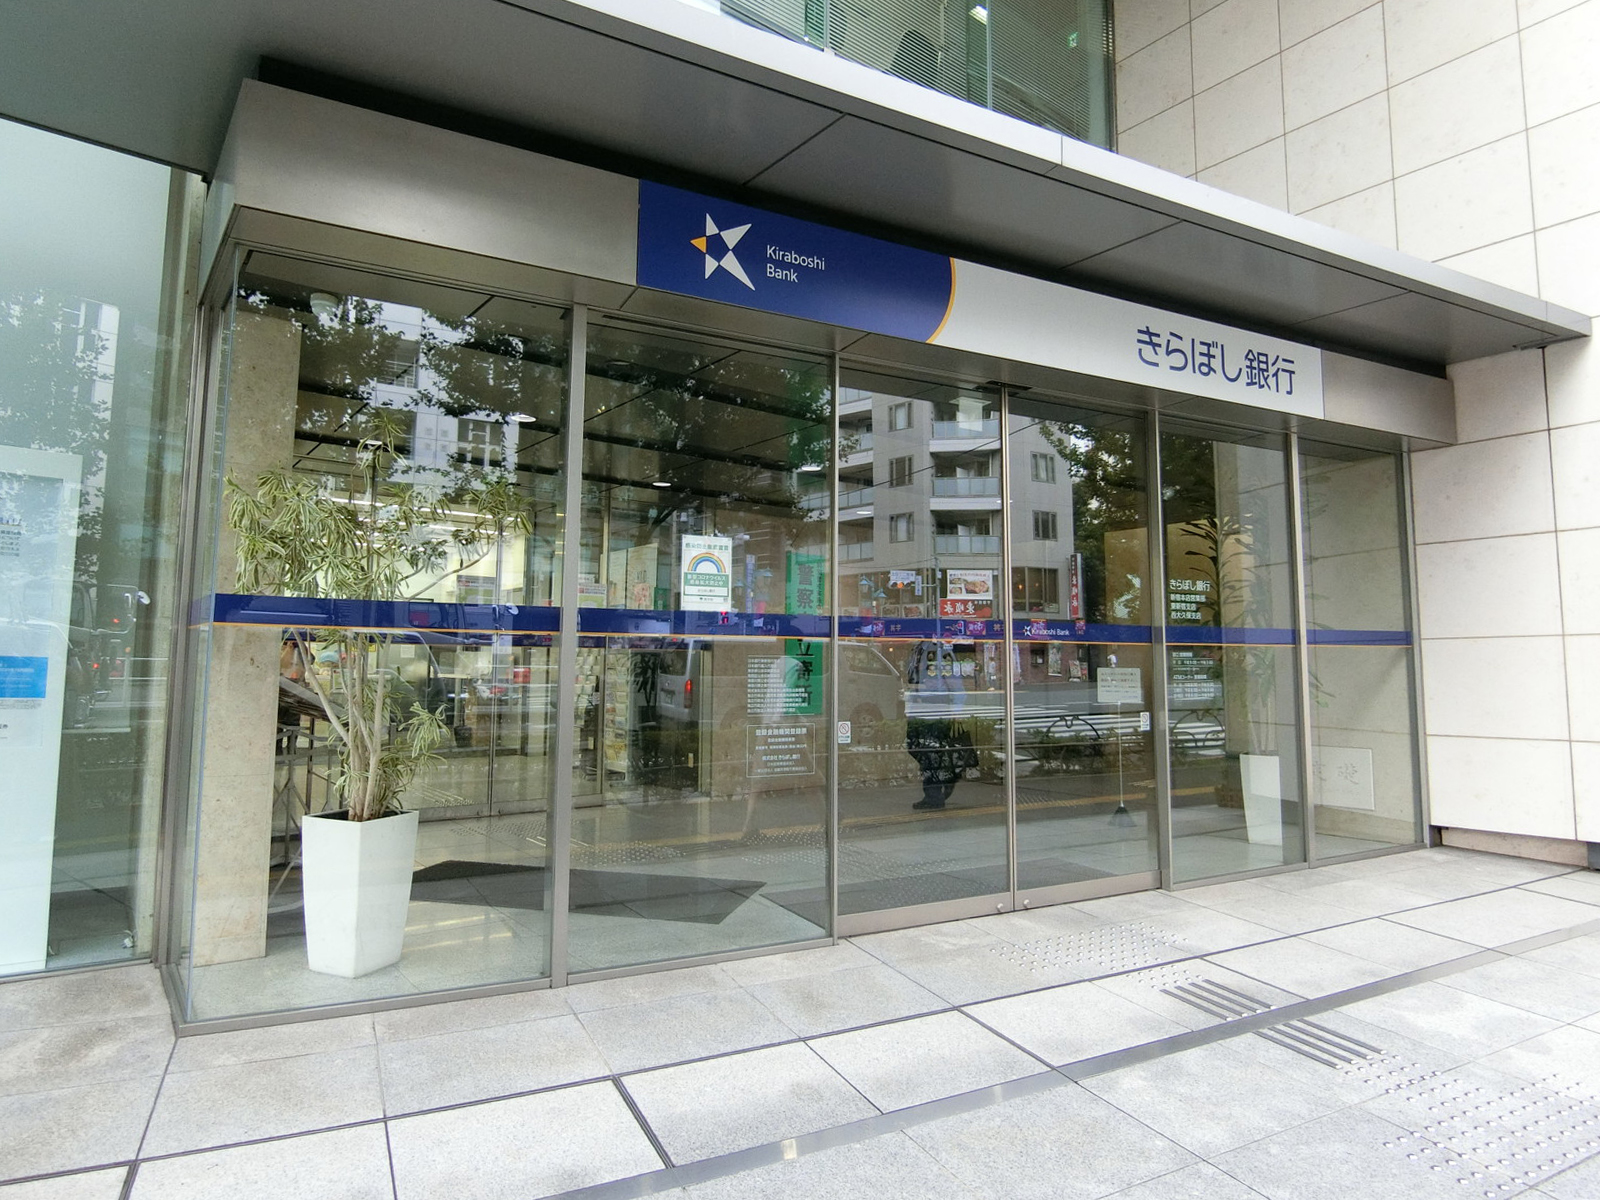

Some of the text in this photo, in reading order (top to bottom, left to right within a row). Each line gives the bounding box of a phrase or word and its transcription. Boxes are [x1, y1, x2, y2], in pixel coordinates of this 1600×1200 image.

[766, 244, 825, 271] Kiraboshi
[766, 263, 798, 283] Bank
[1136, 325, 1296, 396] きらぼし銀行
[1169, 579, 1210, 591] きらぼし銀行
[1031, 627, 1056, 635] Kiraboshi
[1057, 628, 1070, 636] Bank
